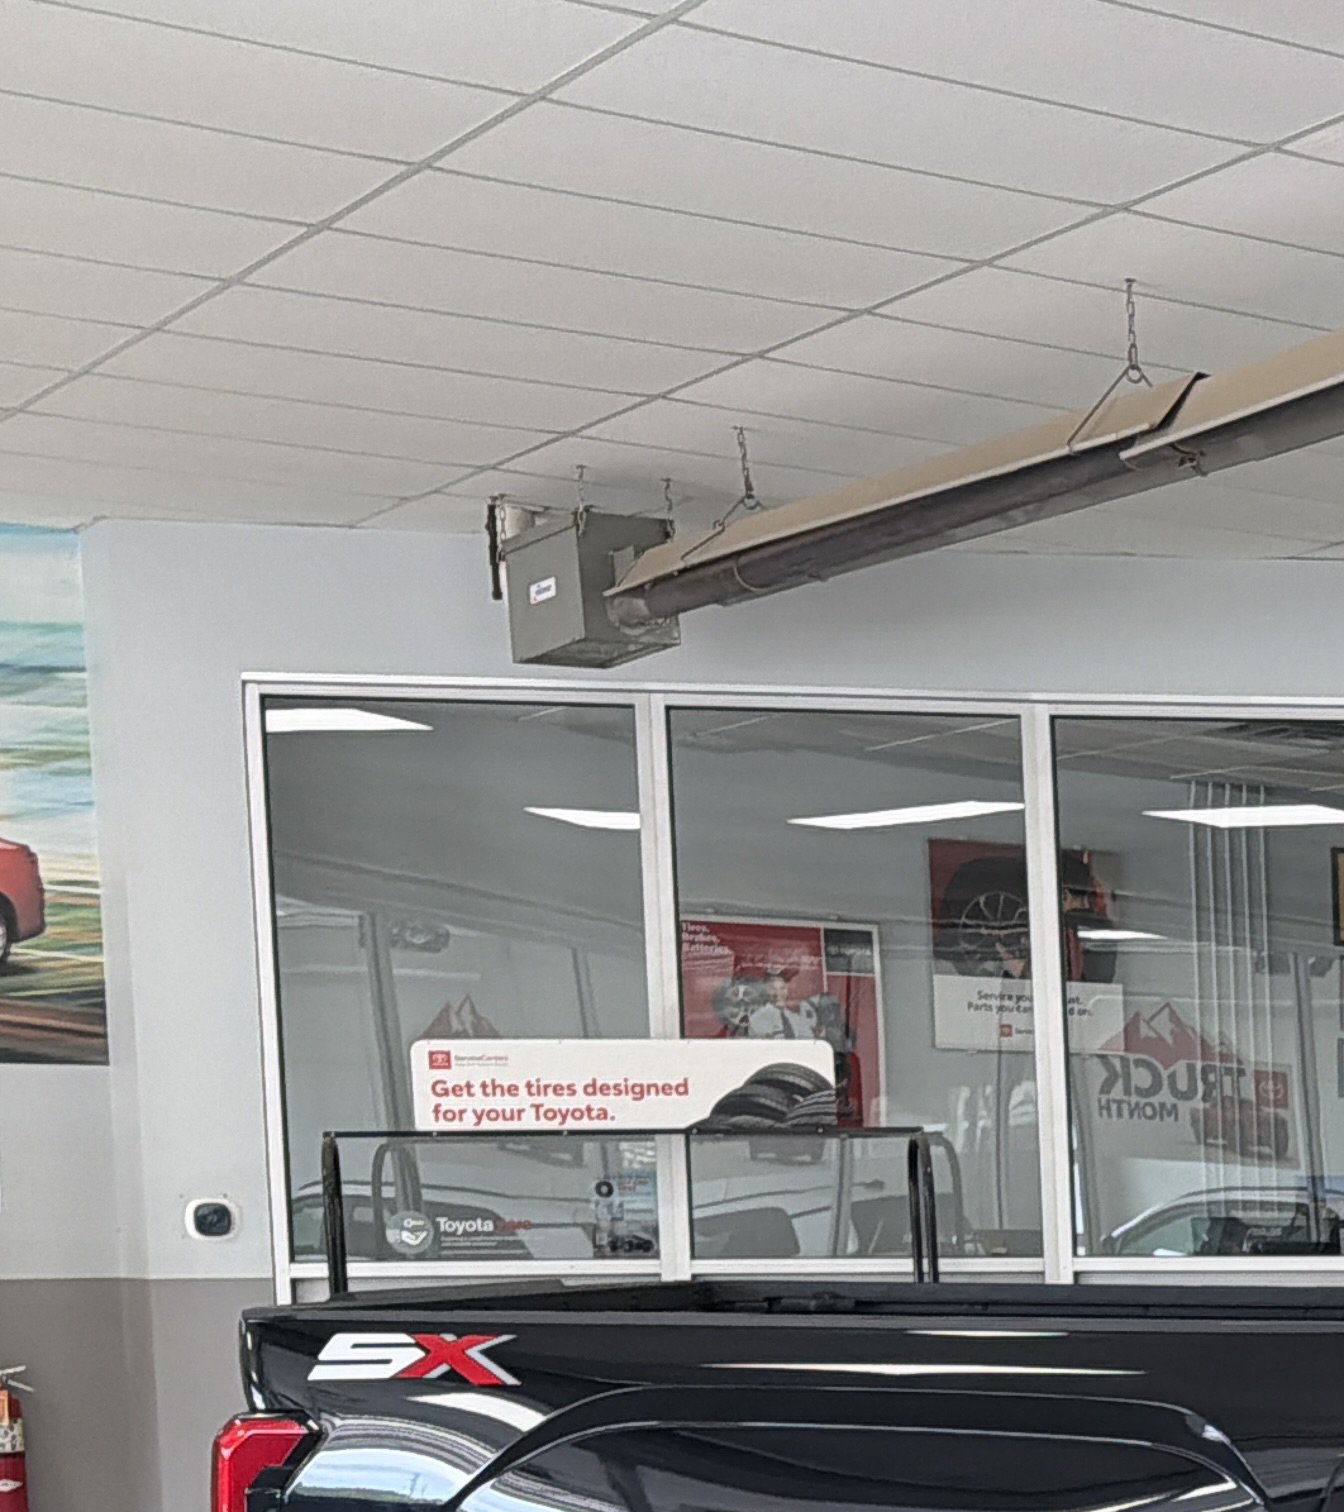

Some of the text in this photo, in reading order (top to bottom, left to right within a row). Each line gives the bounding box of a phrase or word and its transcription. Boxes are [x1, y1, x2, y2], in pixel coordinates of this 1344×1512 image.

[967, 1001, 993, 1012] Parts
[431, 1077, 690, 1101] Get the tires designed
[432, 1103, 616, 1126] for your Toyota.
